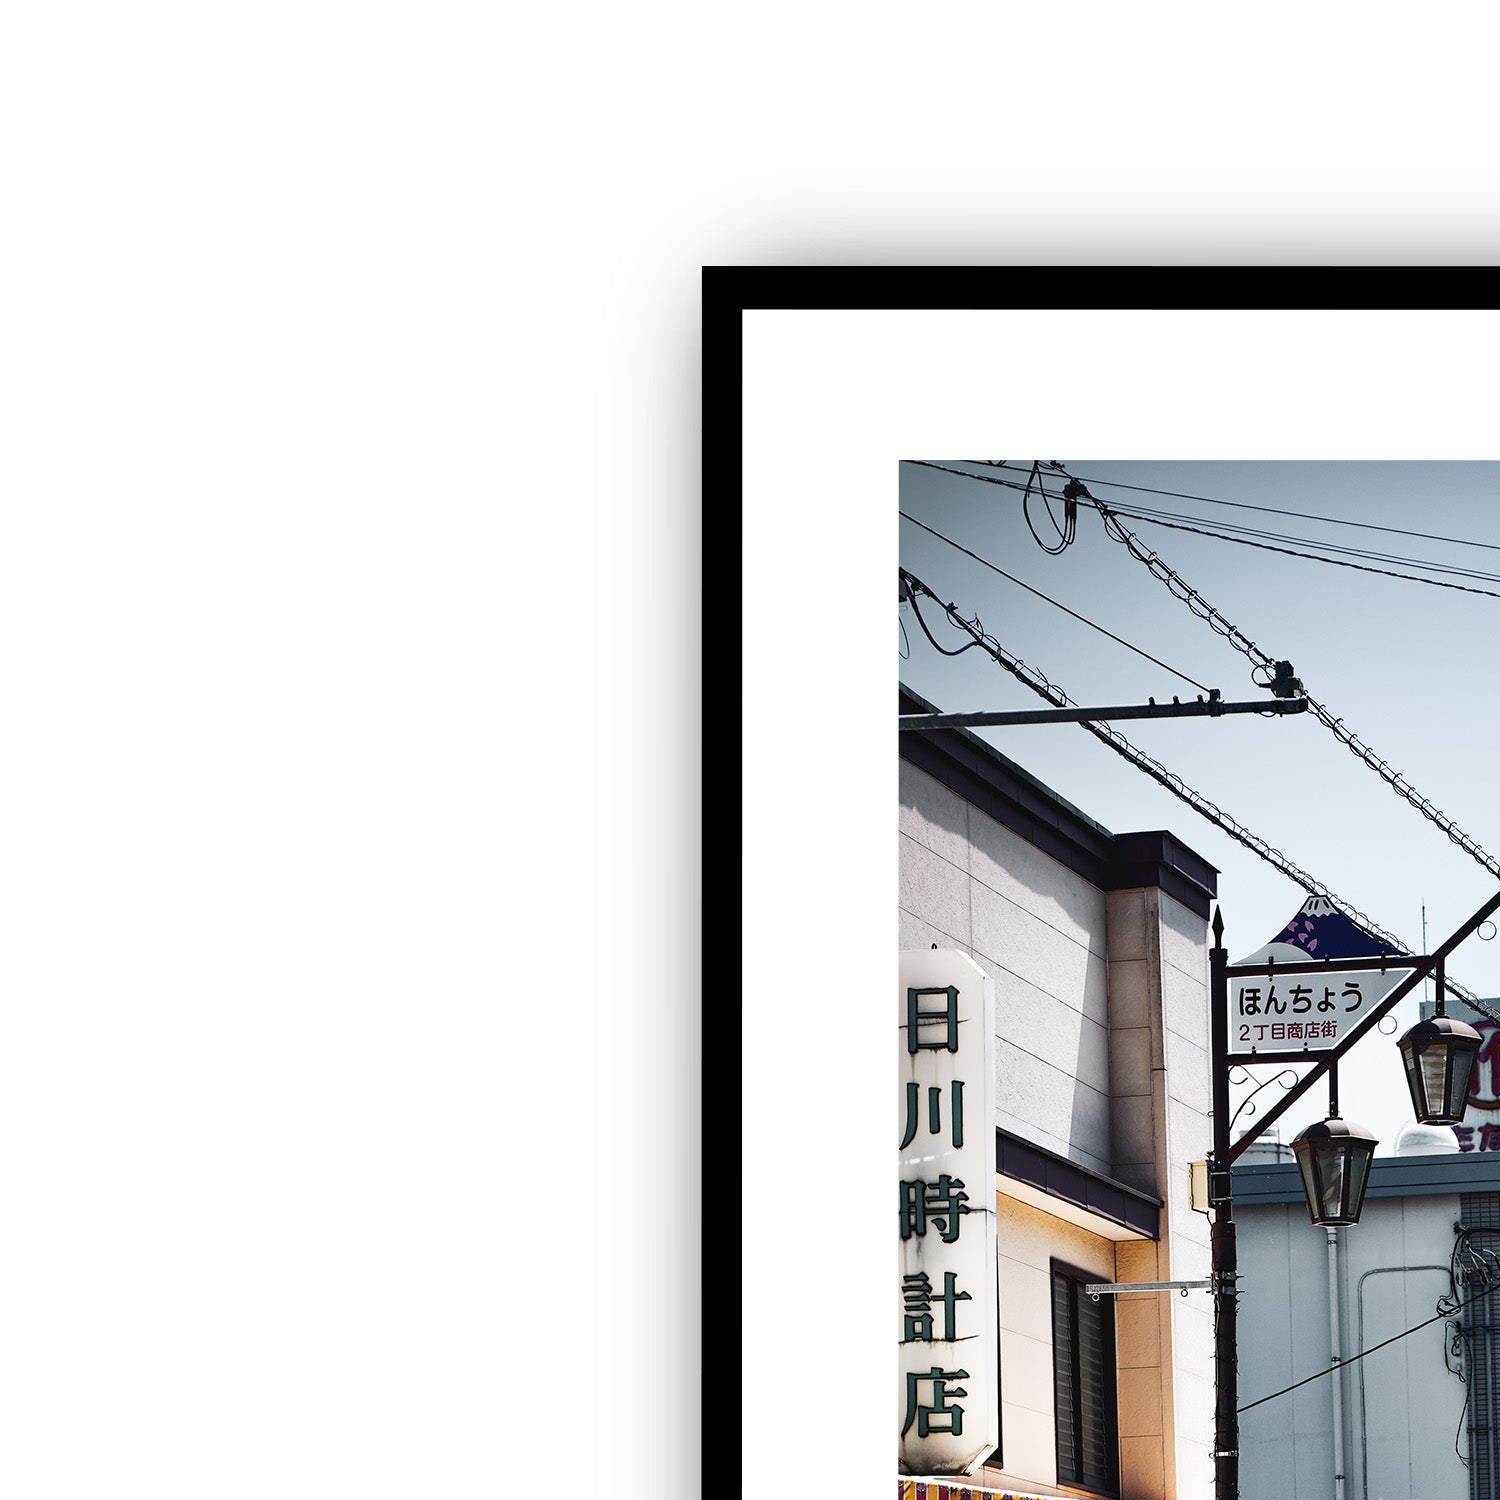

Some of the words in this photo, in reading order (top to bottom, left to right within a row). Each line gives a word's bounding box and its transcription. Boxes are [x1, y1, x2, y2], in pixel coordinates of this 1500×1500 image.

[1238, 982, 1364, 1017] ほんちょう
[1238, 1020, 1338, 1042] 2丁目商店街
[899, 984, 973, 1440] 日川時計店
